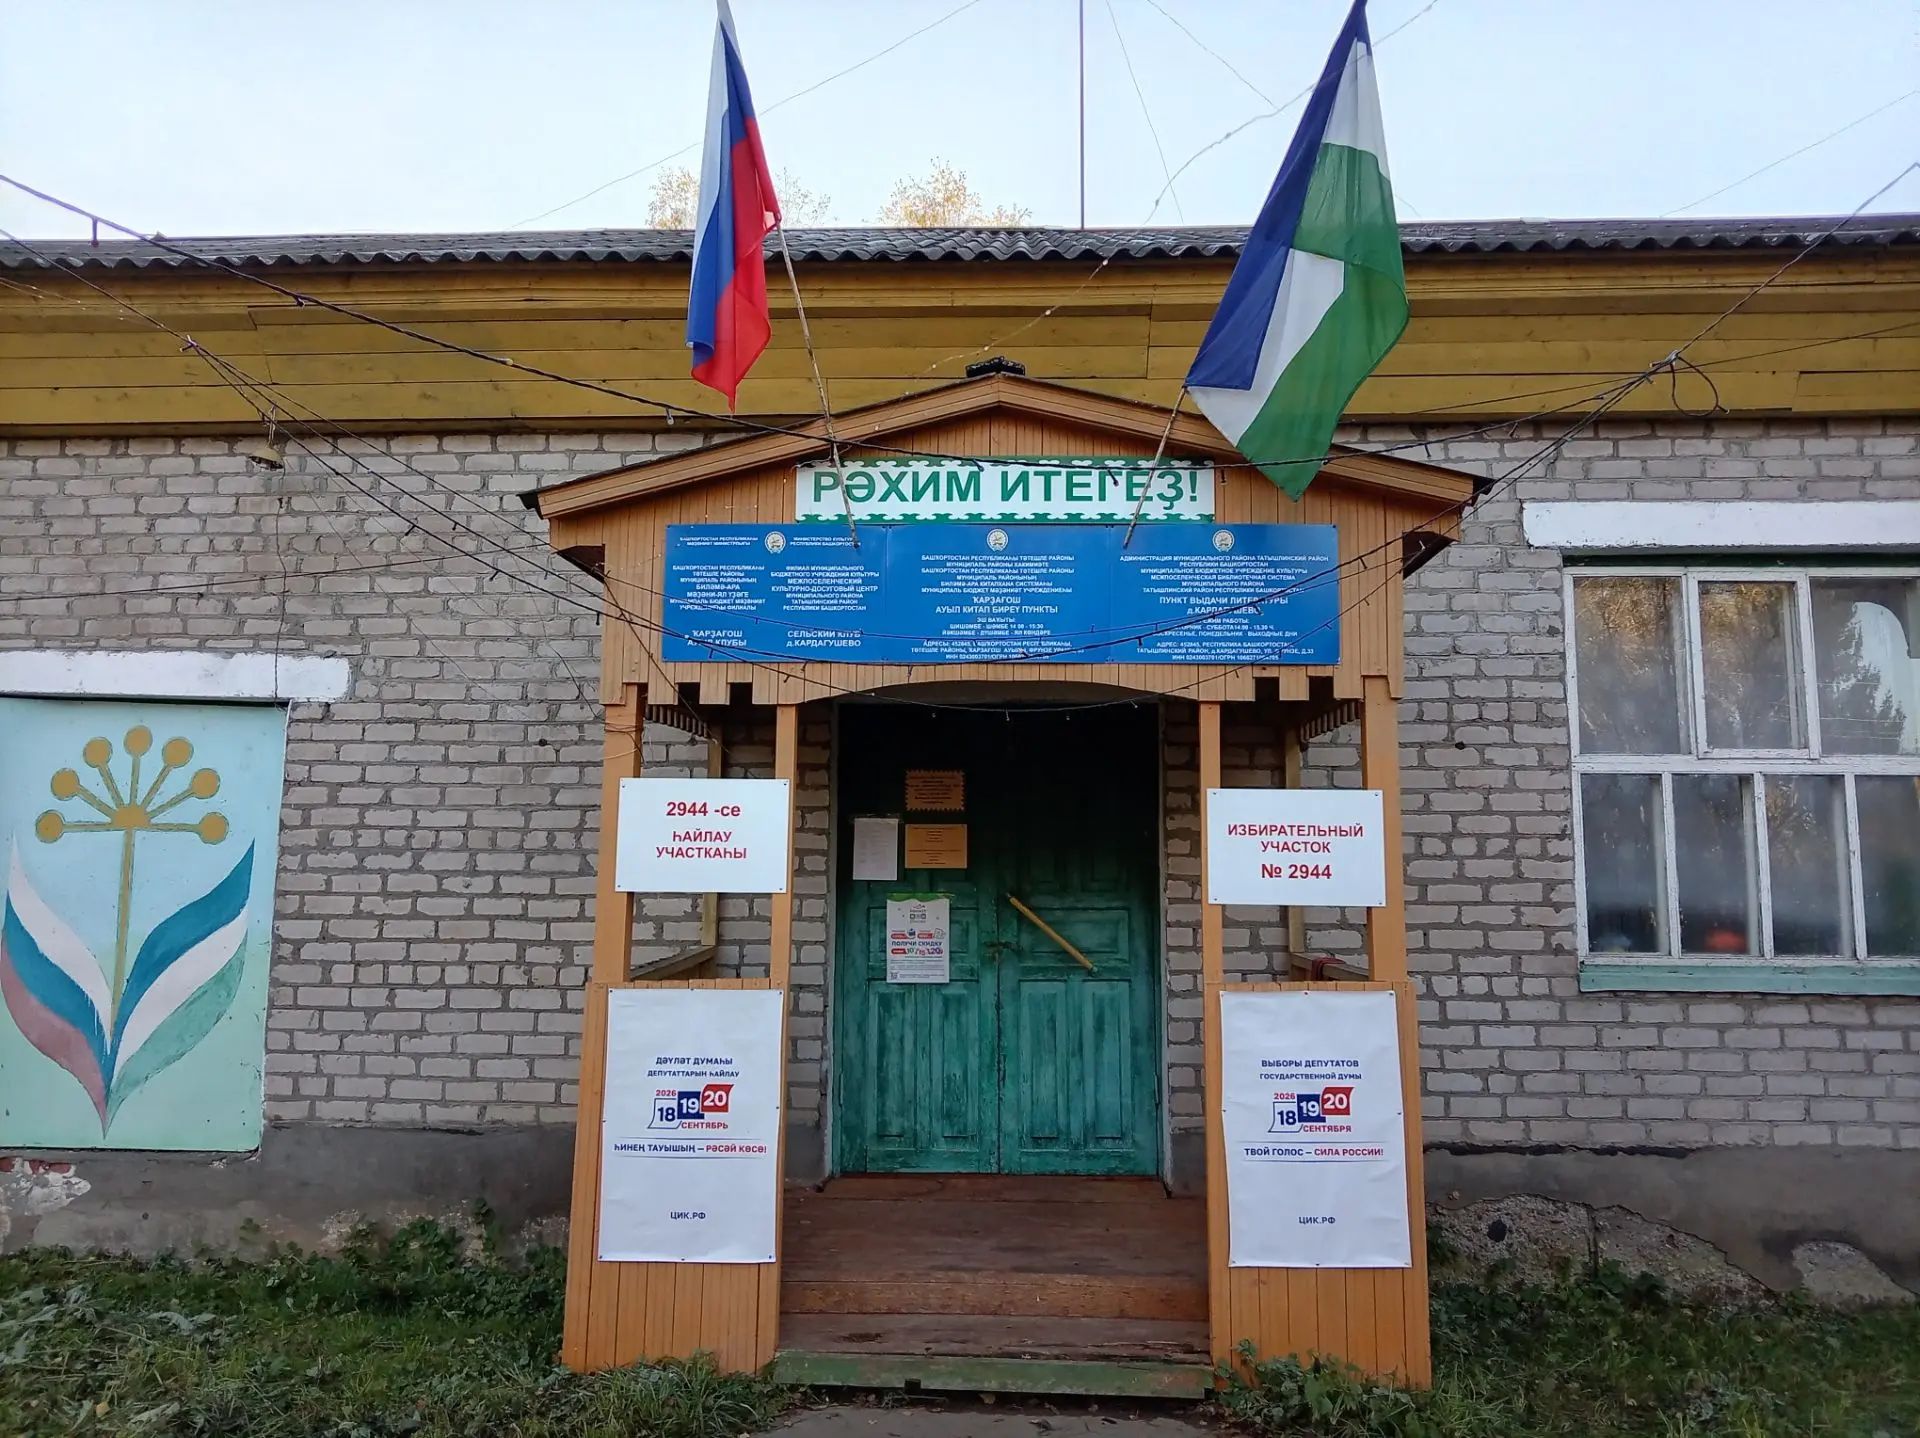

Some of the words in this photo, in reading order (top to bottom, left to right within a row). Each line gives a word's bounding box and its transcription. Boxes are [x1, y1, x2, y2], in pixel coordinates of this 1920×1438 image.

[813, 469, 981, 503] РӘХИМ
[1000, 469, 1199, 511] ИТЕГЕҘ!
[1160, 596, 1188, 604] ПУНКТ
[1190, 596, 1228, 605] ВЫДАЧИ
[1022, 606, 1058, 614] ПУНКТЫ
[786, 640, 861, 648] д.КАРДАГУШЕВО
[666, 802, 708, 816] 2944
[714, 805, 741, 816] -се
[1228, 822, 1364, 837] ИЗБИРАТЕЛЬНЫЙ
[672, 828, 732, 843] ҺАЙЛАУ
[1261, 841, 1331, 853] УЧАСТОК
[656, 846, 747, 859] УЧАСТКАҺЫ
[1261, 864, 1282, 878] №
[1288, 864, 1332, 880] 2944
[656, 1057, 691, 1066] ДӘҮЛӘТ
[693, 1057, 733, 1066] ДУМАҺЫ
[1304, 1060, 1359, 1068] ДЕПУТАТОВ
[647, 1070, 707, 1078] ДЕПУТАТТАРЫН
[709, 1069, 740, 1078] ҺАЙЛАУ
[1260, 1072, 1336, 1081] ГОСУДАРСТВЕННОЙ
[658, 1107, 676, 1122] 18
[680, 1098, 699, 1114] 19
[703, 1091, 727, 1106] 20
[1277, 1111, 1296, 1126] 18
[1300, 1101, 1319, 1117] 19
[1324, 1094, 1348, 1110] 20
[614, 1143, 645, 1153] ҺИНЕҢ
[648, 1144, 696, 1153] ТАУЫШЫҢ
[706, 1143, 737, 1153] РӘСӘЙ
[1244, 1147, 1270, 1156] ТВОЙ
[670, 1212, 706, 1220] ЦИК.РФ
[1299, 1216, 1336, 1225] ЦИК.РФ
